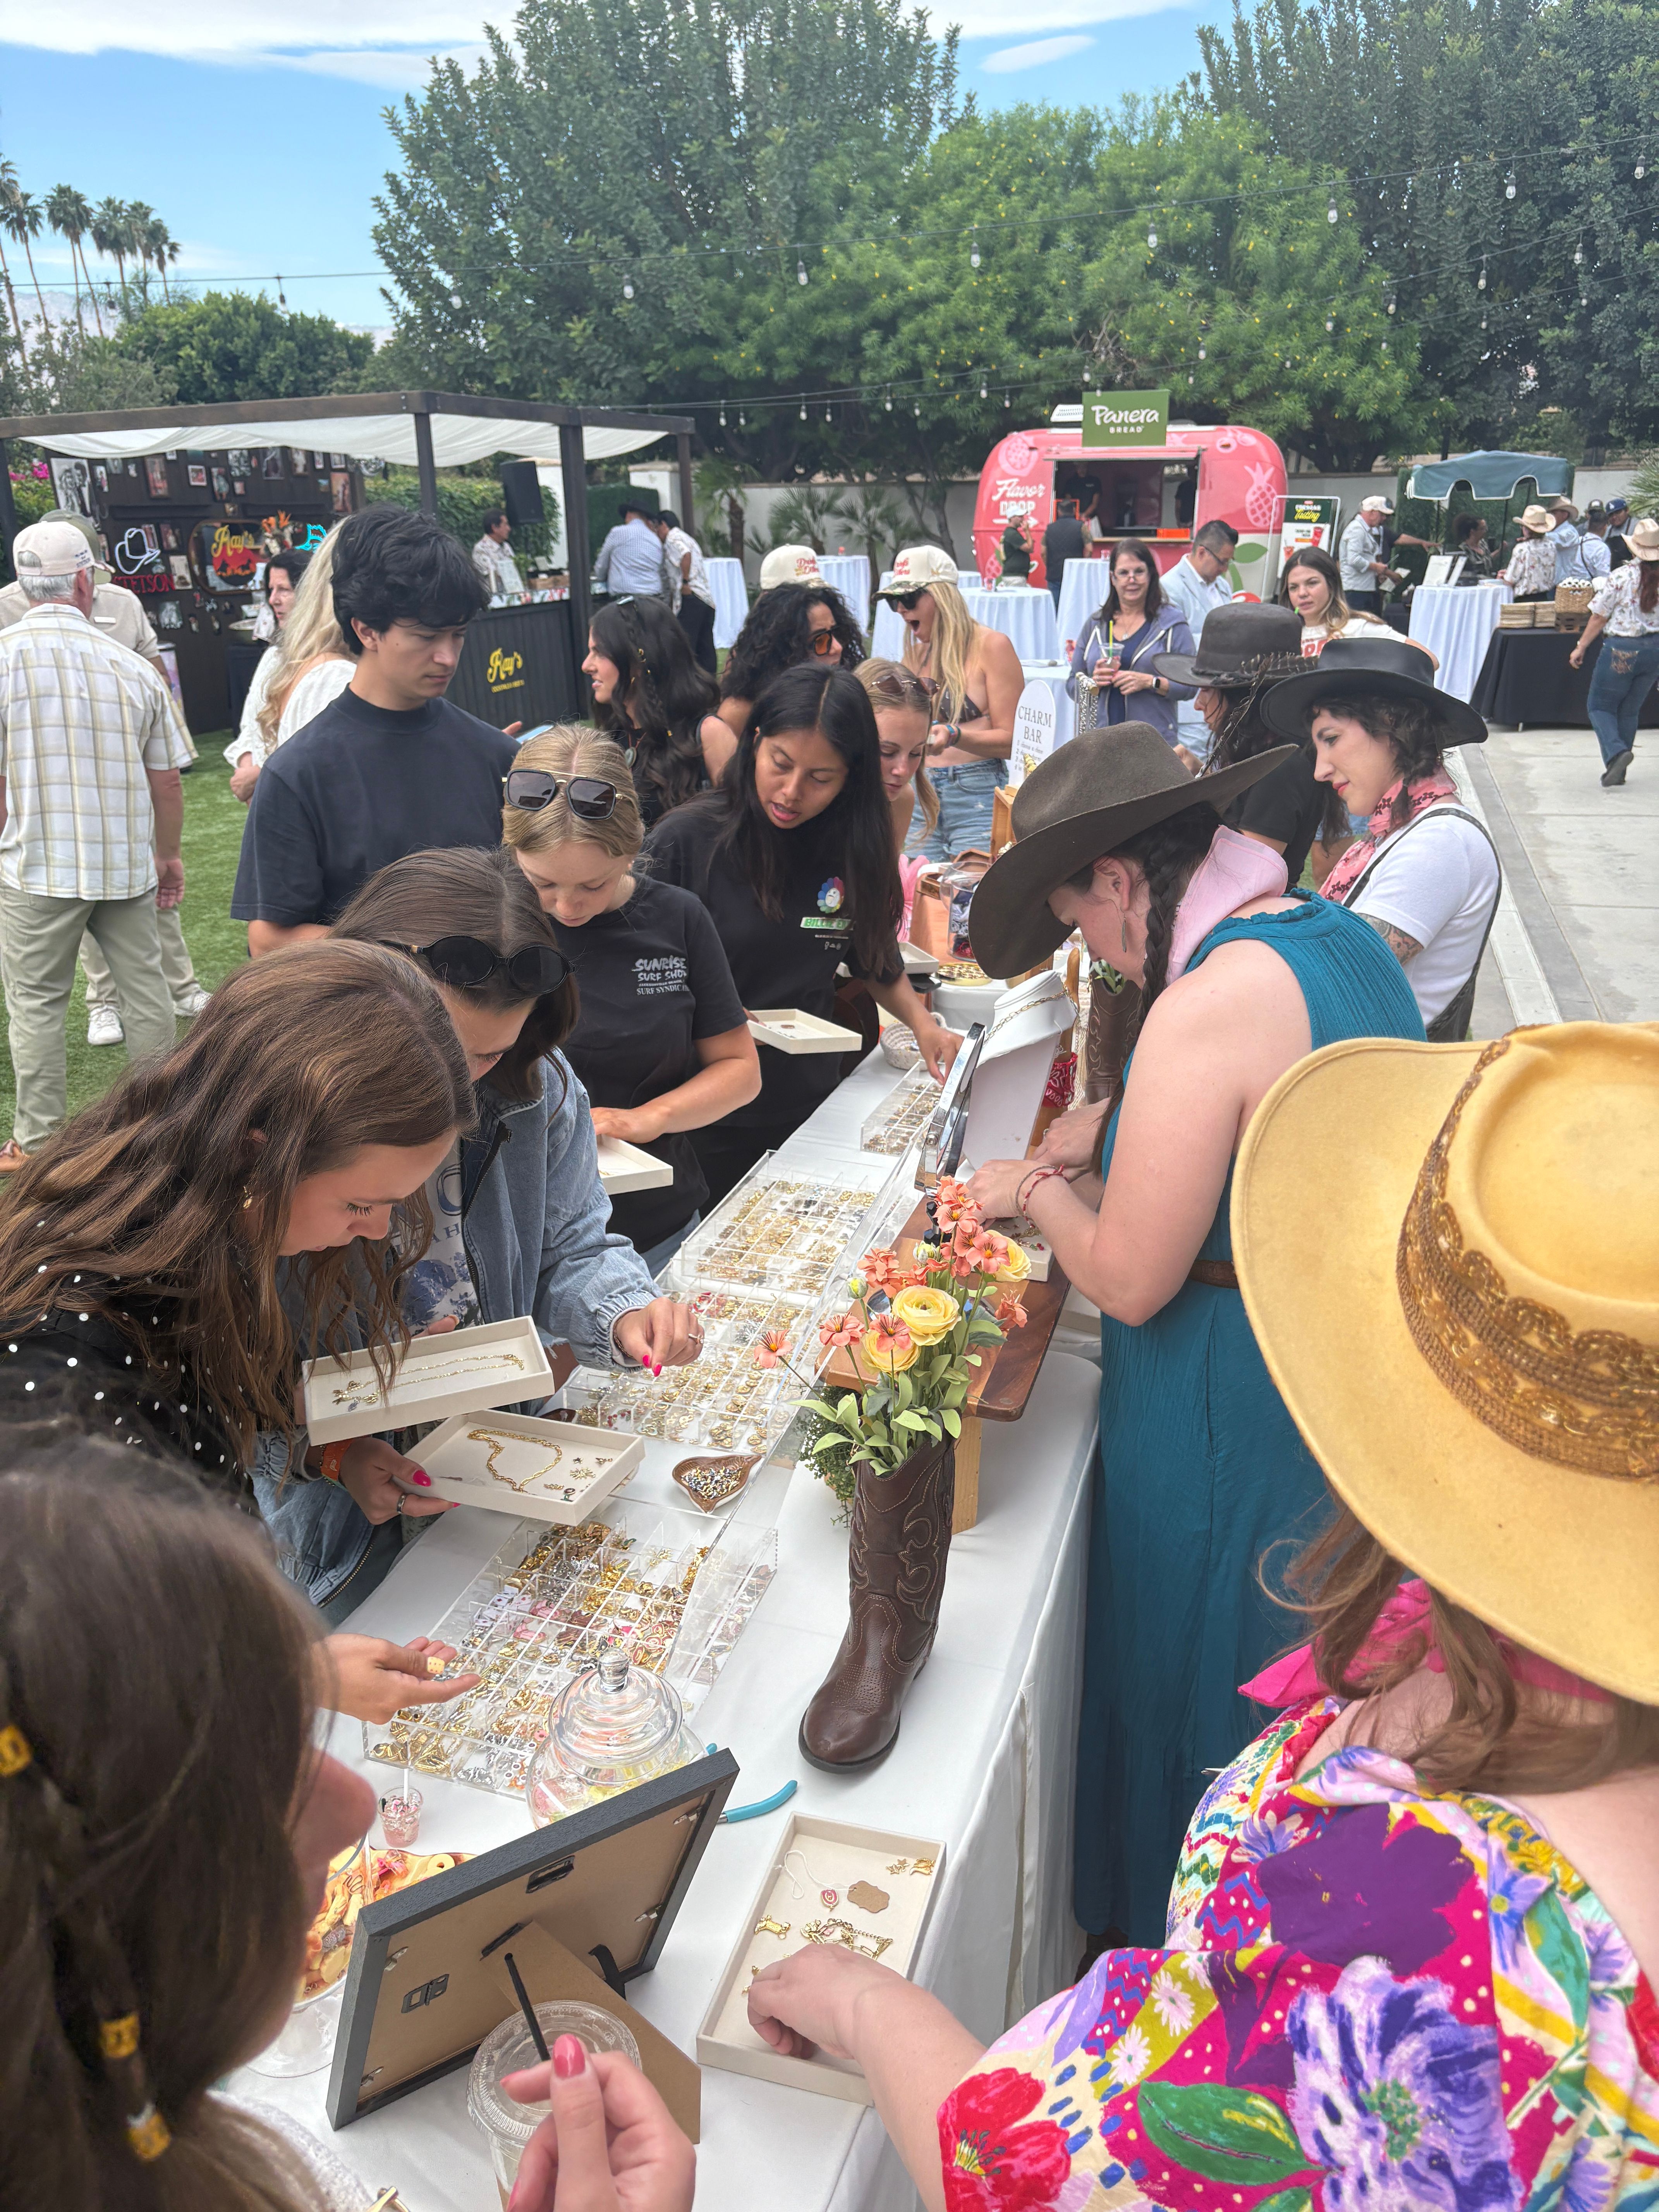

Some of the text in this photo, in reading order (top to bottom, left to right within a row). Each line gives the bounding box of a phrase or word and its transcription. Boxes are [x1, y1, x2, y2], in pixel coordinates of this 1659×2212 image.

[1091, 405, 1159, 425] Panera
[991, 478, 1046, 501] Flavor
[211, 525, 254, 558] Ray's
[487, 647, 523, 683] Ray's
[1018, 706, 1051, 728] CHARM
[1024, 726, 1041, 744] BAR
[632, 955, 687, 971] SUNRISE
[638, 972, 661, 982] SURF
